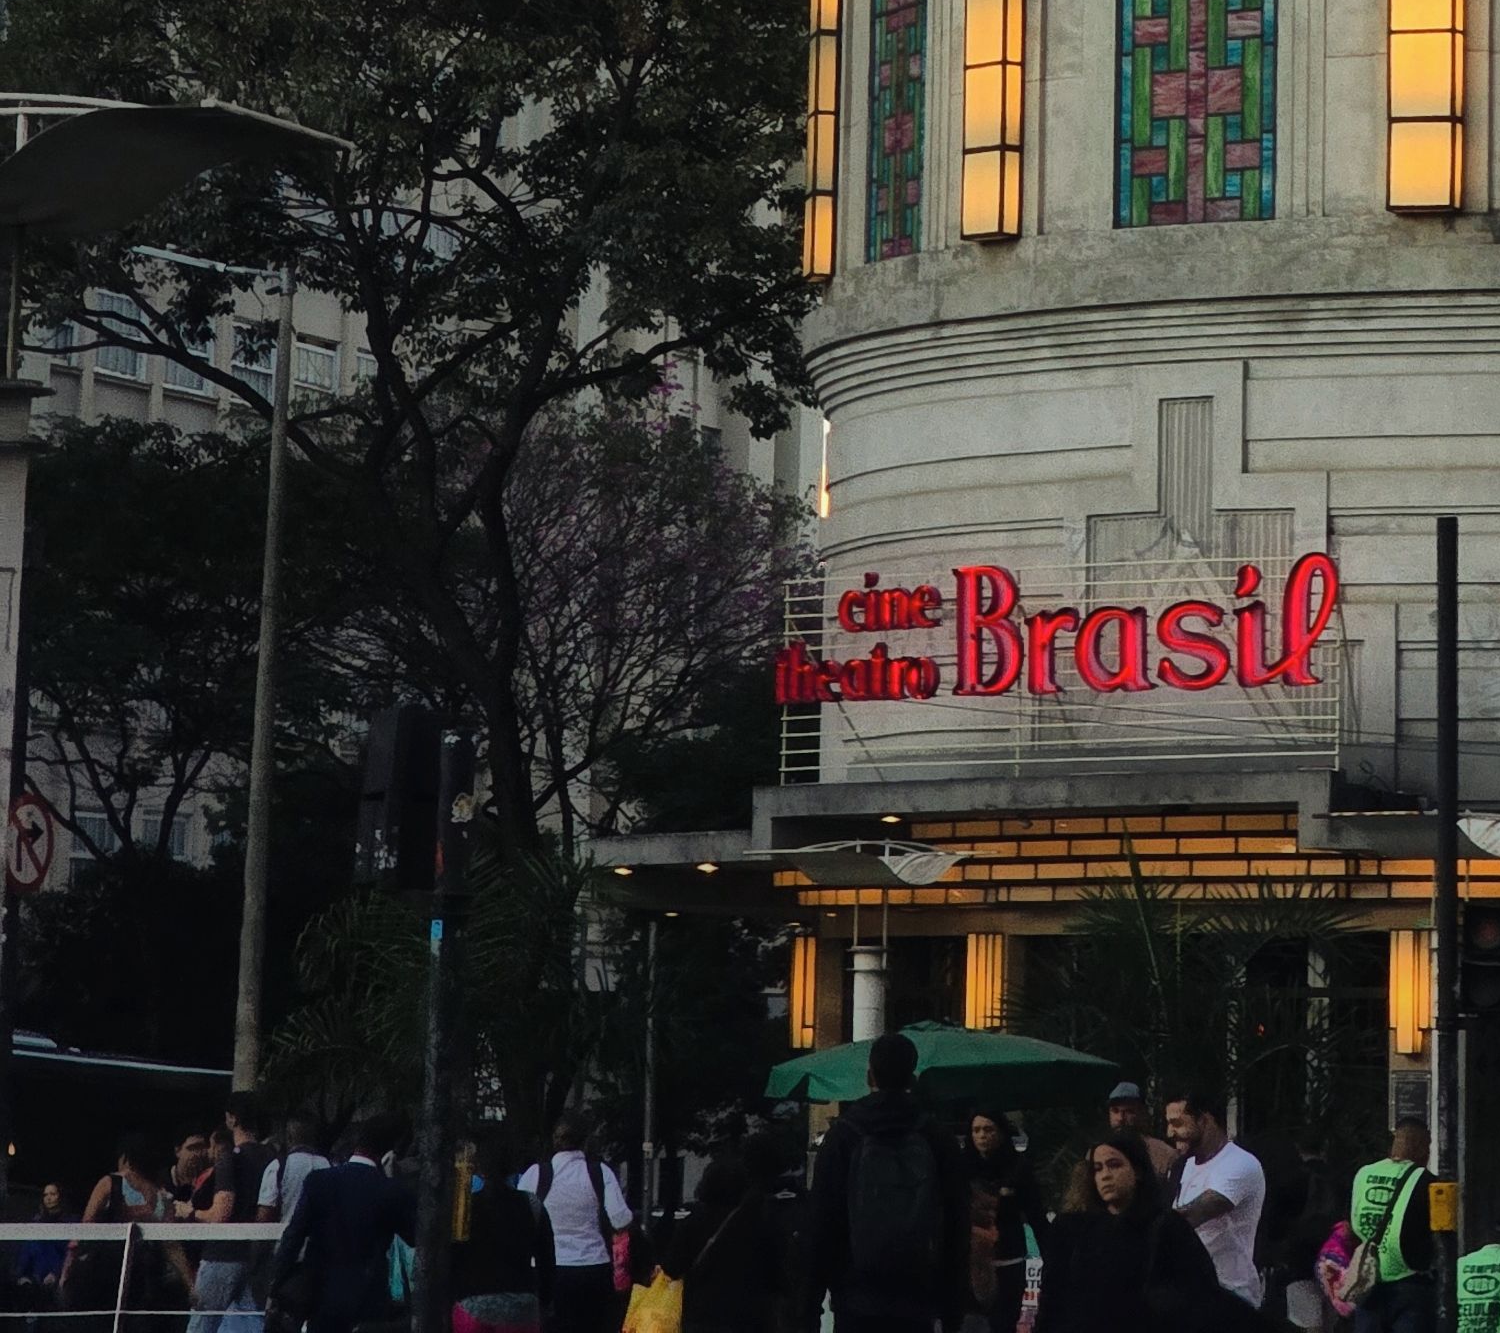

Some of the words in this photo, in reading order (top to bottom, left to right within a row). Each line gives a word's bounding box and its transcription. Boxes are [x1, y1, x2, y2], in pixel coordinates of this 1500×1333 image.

[838, 572, 942, 632] cine
[952, 552, 1338, 696] Brasil
[775, 642, 941, 704] theatro
